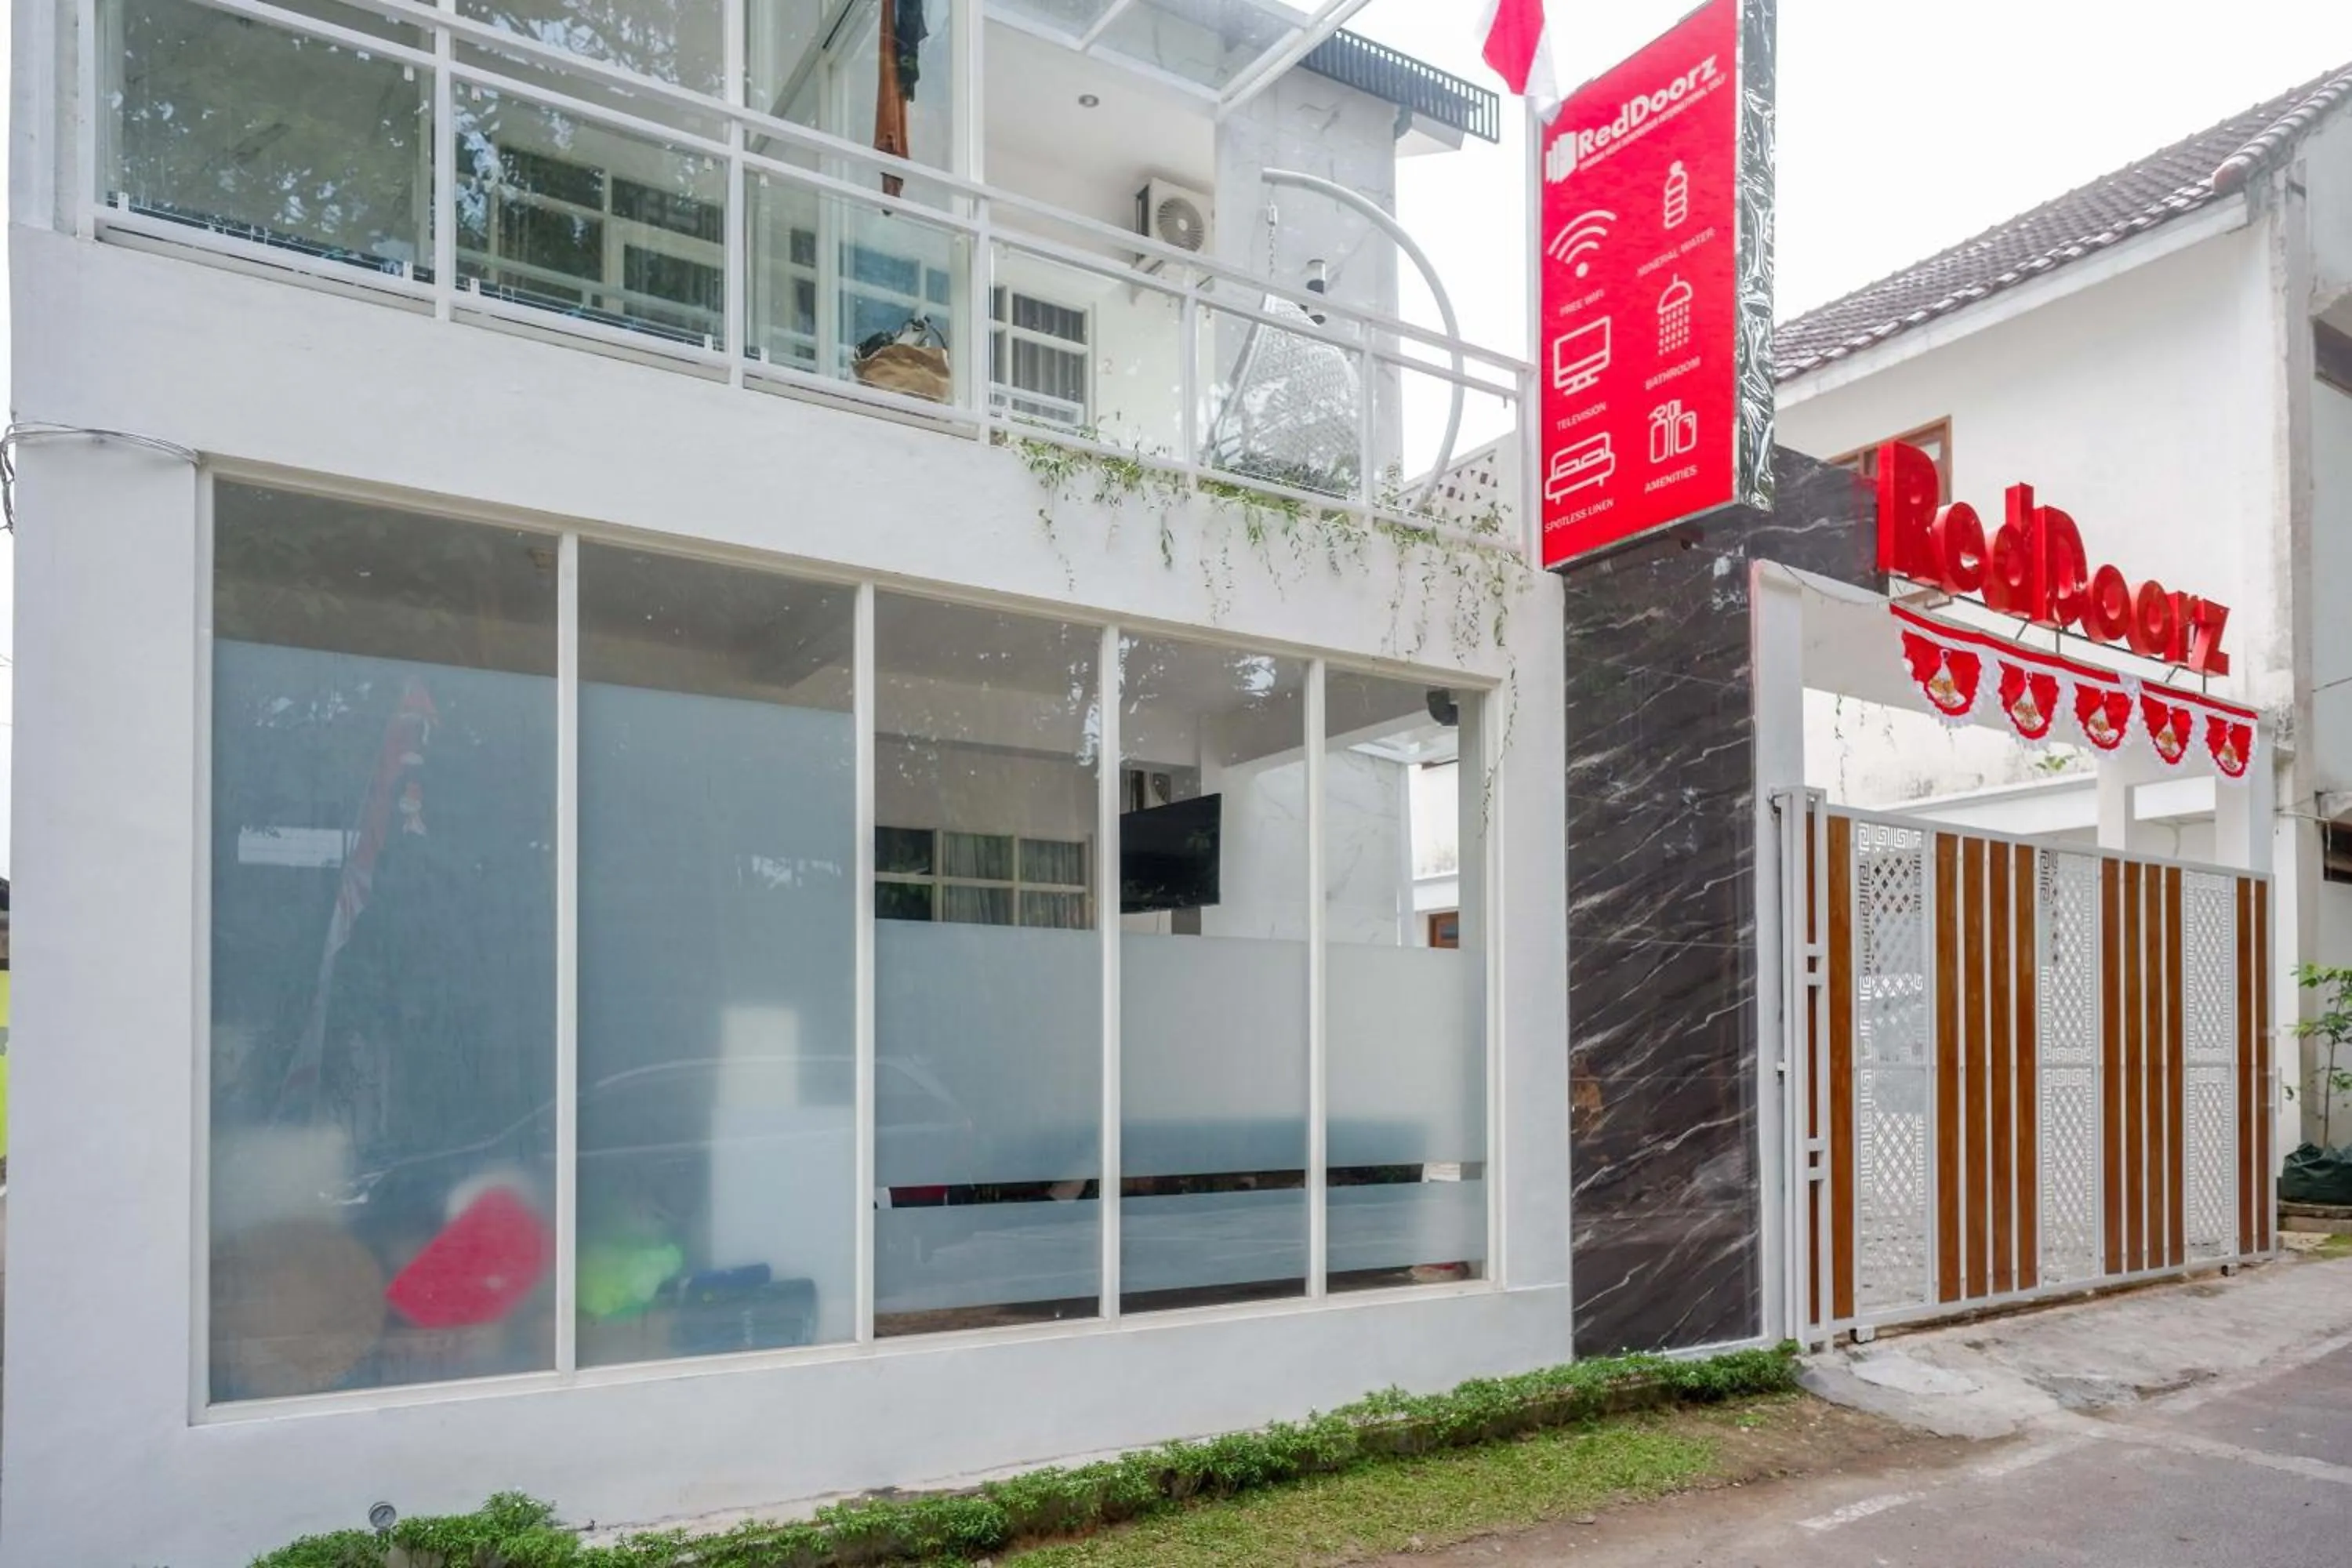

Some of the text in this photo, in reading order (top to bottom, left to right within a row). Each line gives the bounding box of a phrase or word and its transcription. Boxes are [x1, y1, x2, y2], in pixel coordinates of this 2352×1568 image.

[1578, 54, 1717, 160] RedDoorz
[1644, 356, 1700, 390] BATHROOM
[1556, 401, 1607, 431] TELEVISION
[1645, 464, 1697, 494] AMENITIES
[1544, 498, 1615, 533] SPOTLESS LINEN
[1877, 440, 2230, 677] RedDoorz
